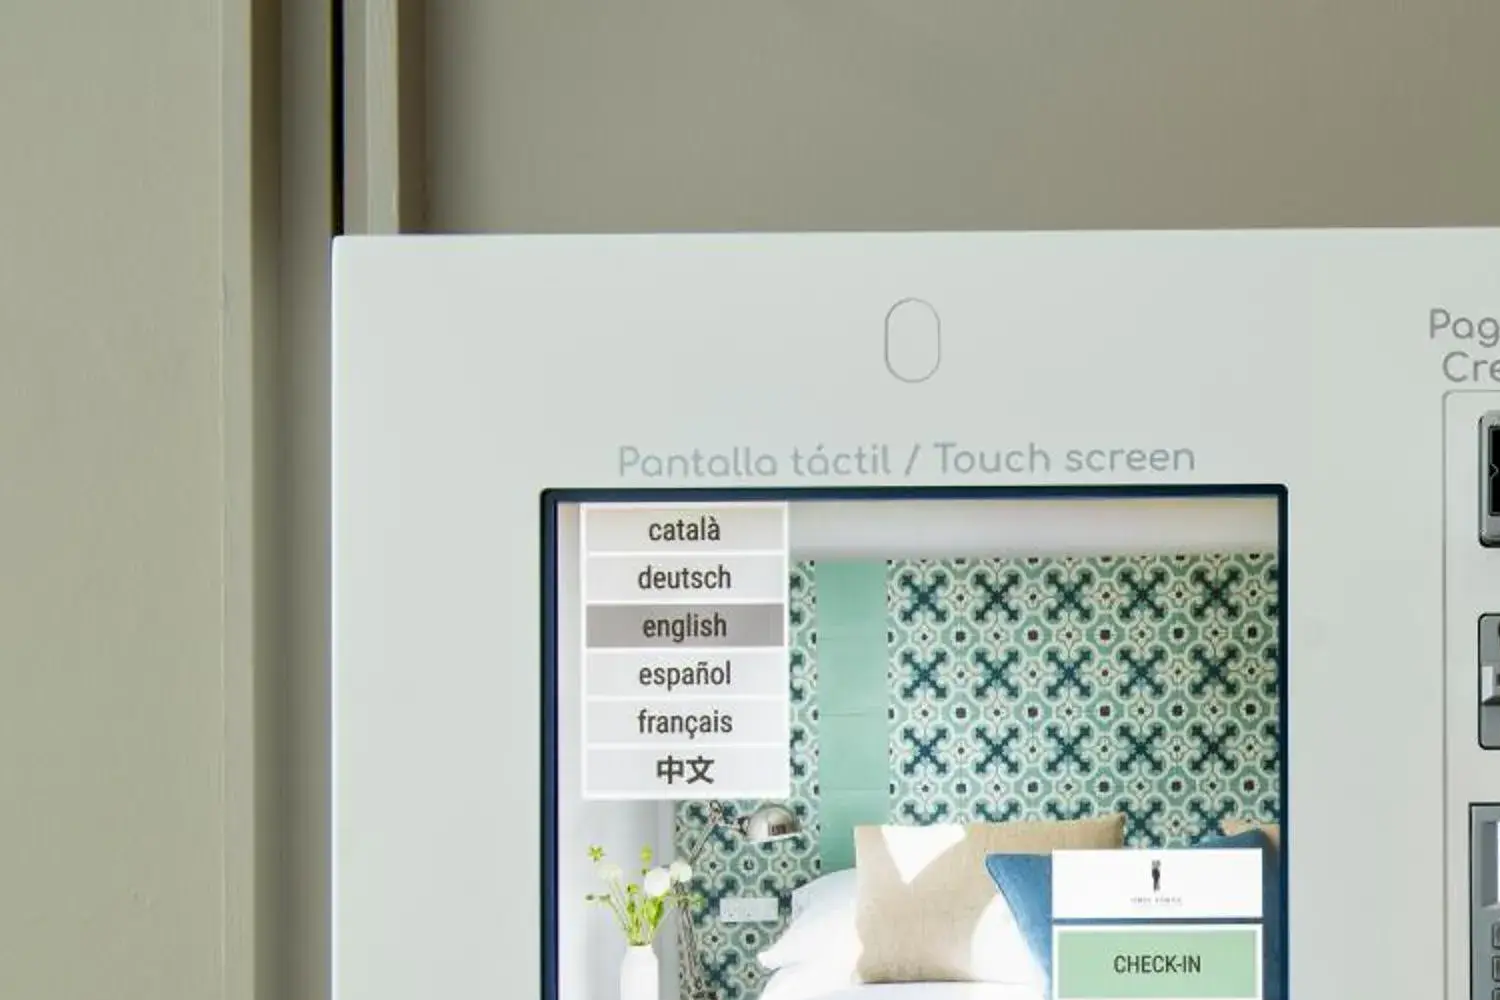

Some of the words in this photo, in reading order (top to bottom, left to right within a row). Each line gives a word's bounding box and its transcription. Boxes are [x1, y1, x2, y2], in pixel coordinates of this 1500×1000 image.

[619, 445, 778, 478] Pantalla
[790, 443, 892, 477] táctil
[904, 443, 922, 477] /
[932, 441, 1051, 475] Touch
[1065, 447, 1195, 473] screen
[648, 515, 721, 542] català
[637, 563, 732, 590] deutsch
[642, 611, 727, 644] english
[639, 659, 731, 692] español
[637, 708, 733, 740] français
[656, 754, 715, 785] 中文
[1113, 954, 1201, 974] CHECK-IN
